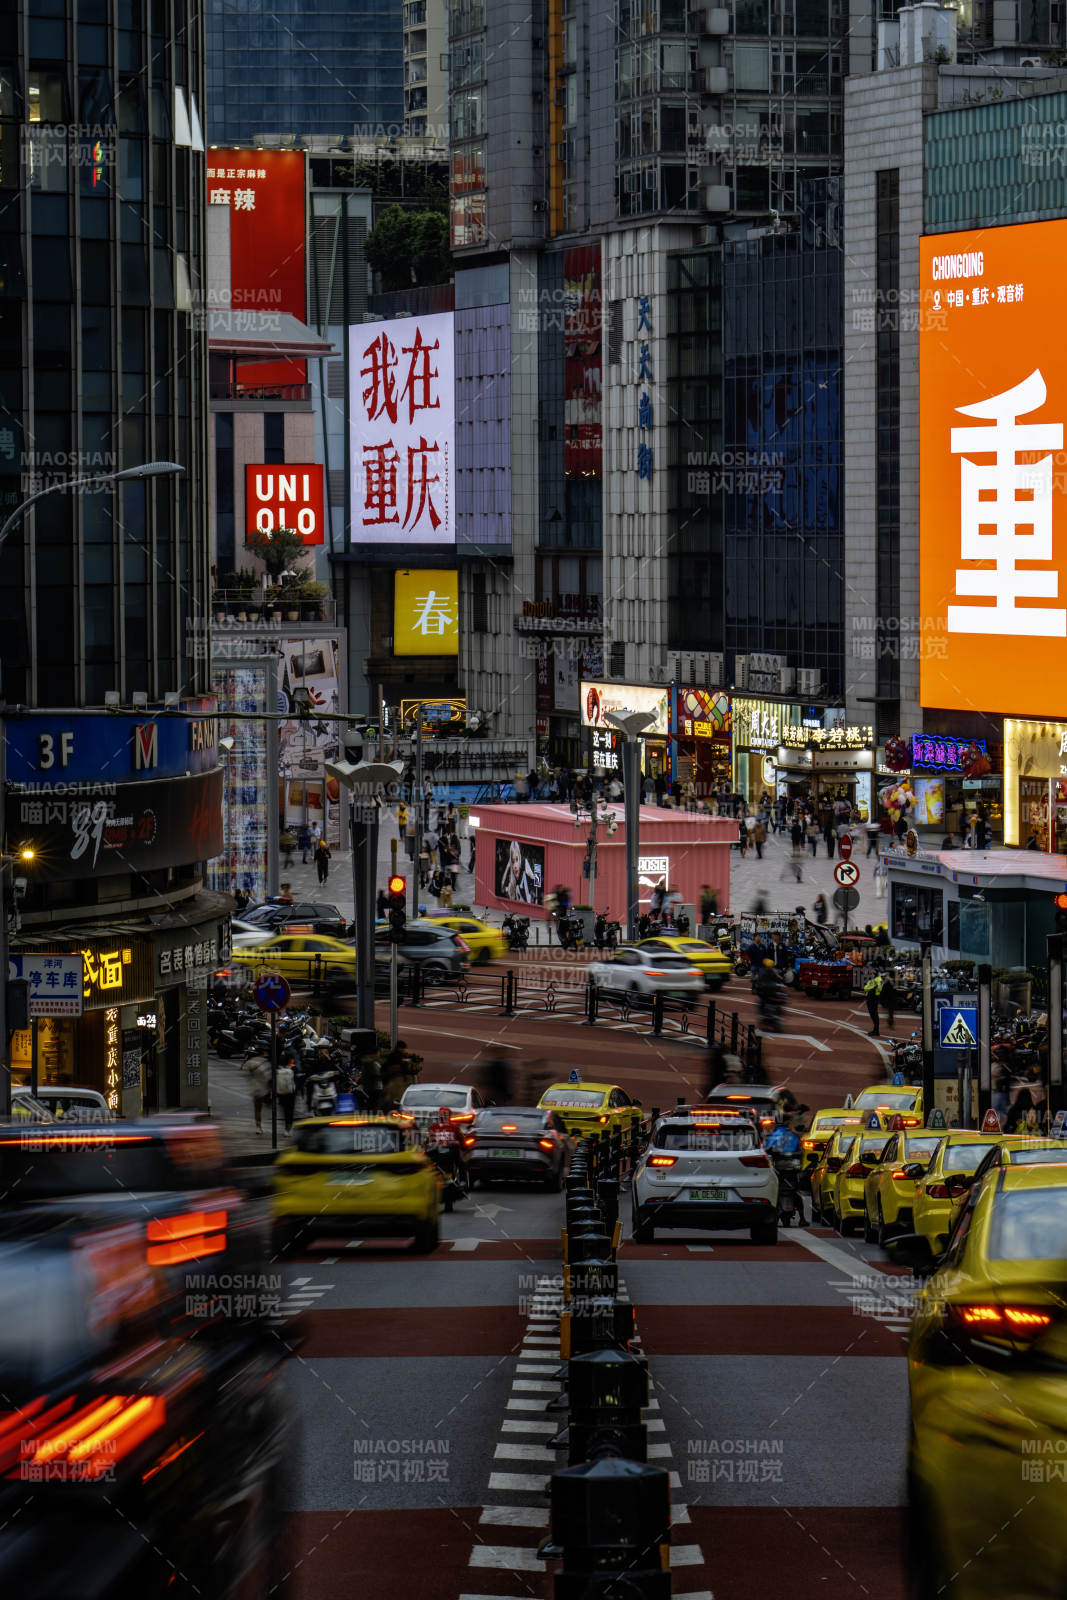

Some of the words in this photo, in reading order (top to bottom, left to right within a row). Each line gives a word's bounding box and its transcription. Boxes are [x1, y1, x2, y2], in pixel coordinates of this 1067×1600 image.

[210, 188, 256, 211] 麻辣
[932, 251, 984, 280] CHONGQING
[360, 325, 441, 424] 我在
[256, 474, 310, 501] UNI
[362, 435, 442, 532] 重庆
[947, 367, 1067, 637] 重
[256, 507, 316, 539] QLO
[411, 590, 458, 635] 春
[593, 750, 618, 769] 我在重庆
[29, 970, 78, 988] 停车库
